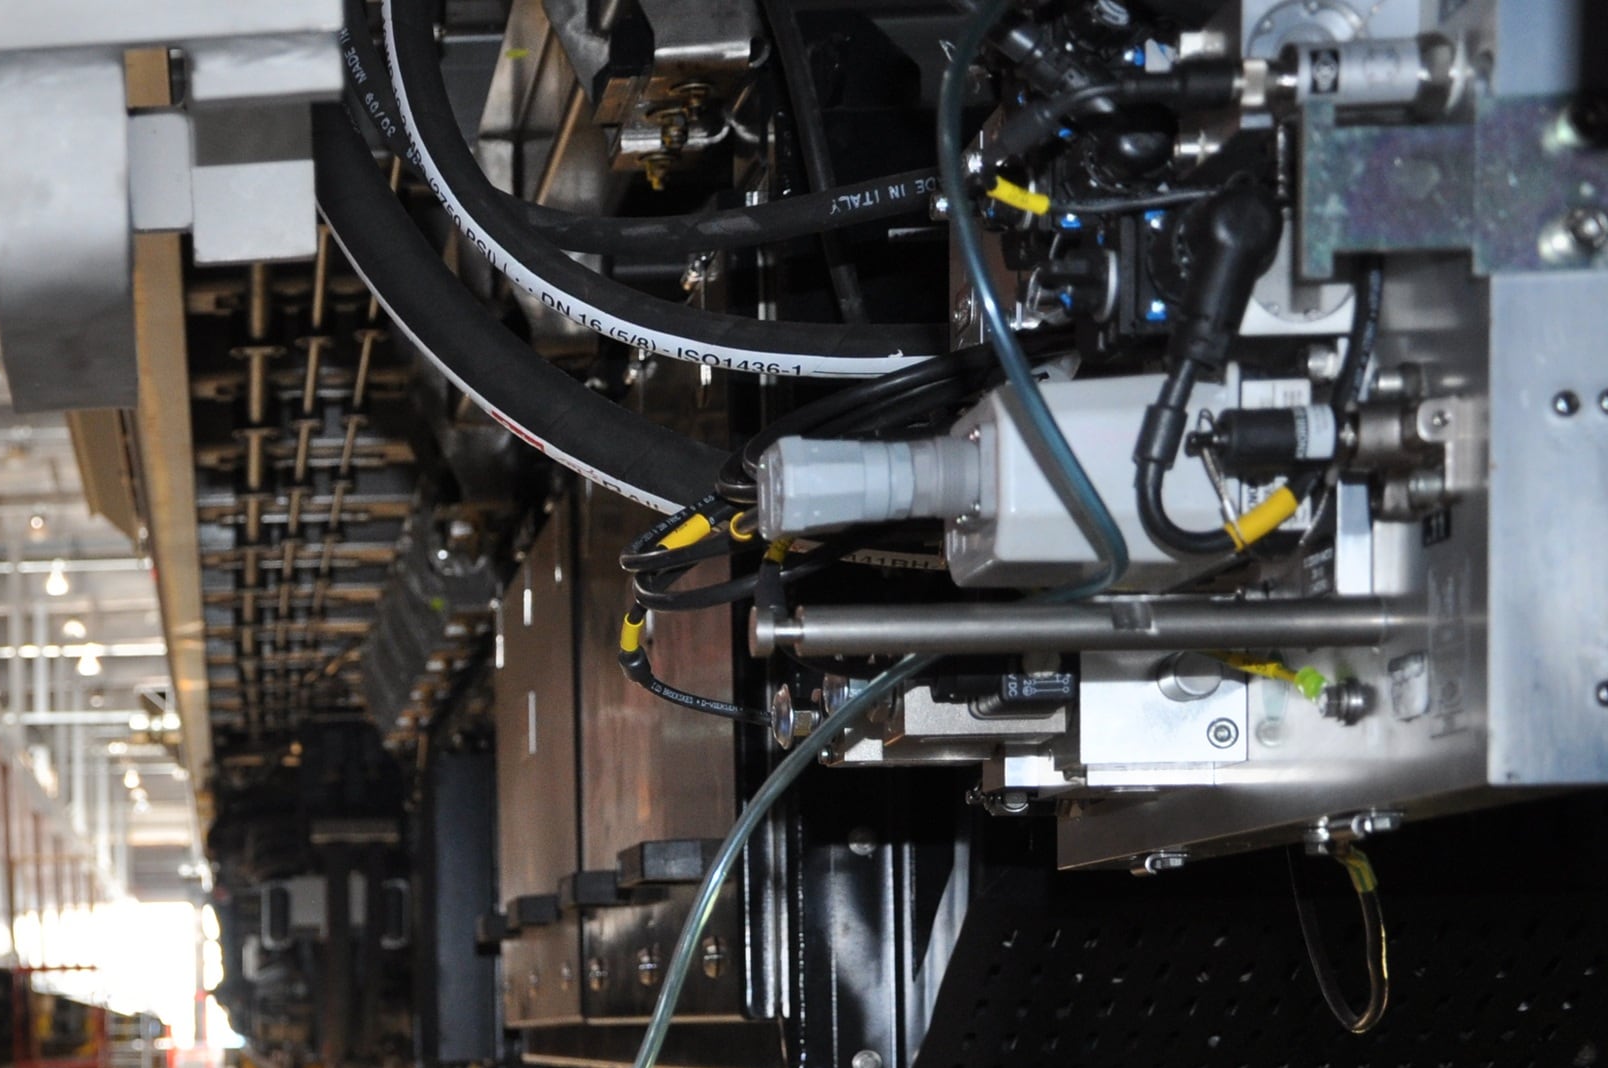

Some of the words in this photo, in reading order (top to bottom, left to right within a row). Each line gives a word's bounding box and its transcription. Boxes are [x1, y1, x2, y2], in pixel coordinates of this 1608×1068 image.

[344, 47, 367, 84] MADE
[830, 190, 880, 215] ITALY
[888, 184, 906, 200] IN
[542, 291, 570, 316] DN
[579, 314, 602, 332] 16
[610, 327, 657, 350] (5/8)
[677, 347, 802, 375] ISO1436-1
